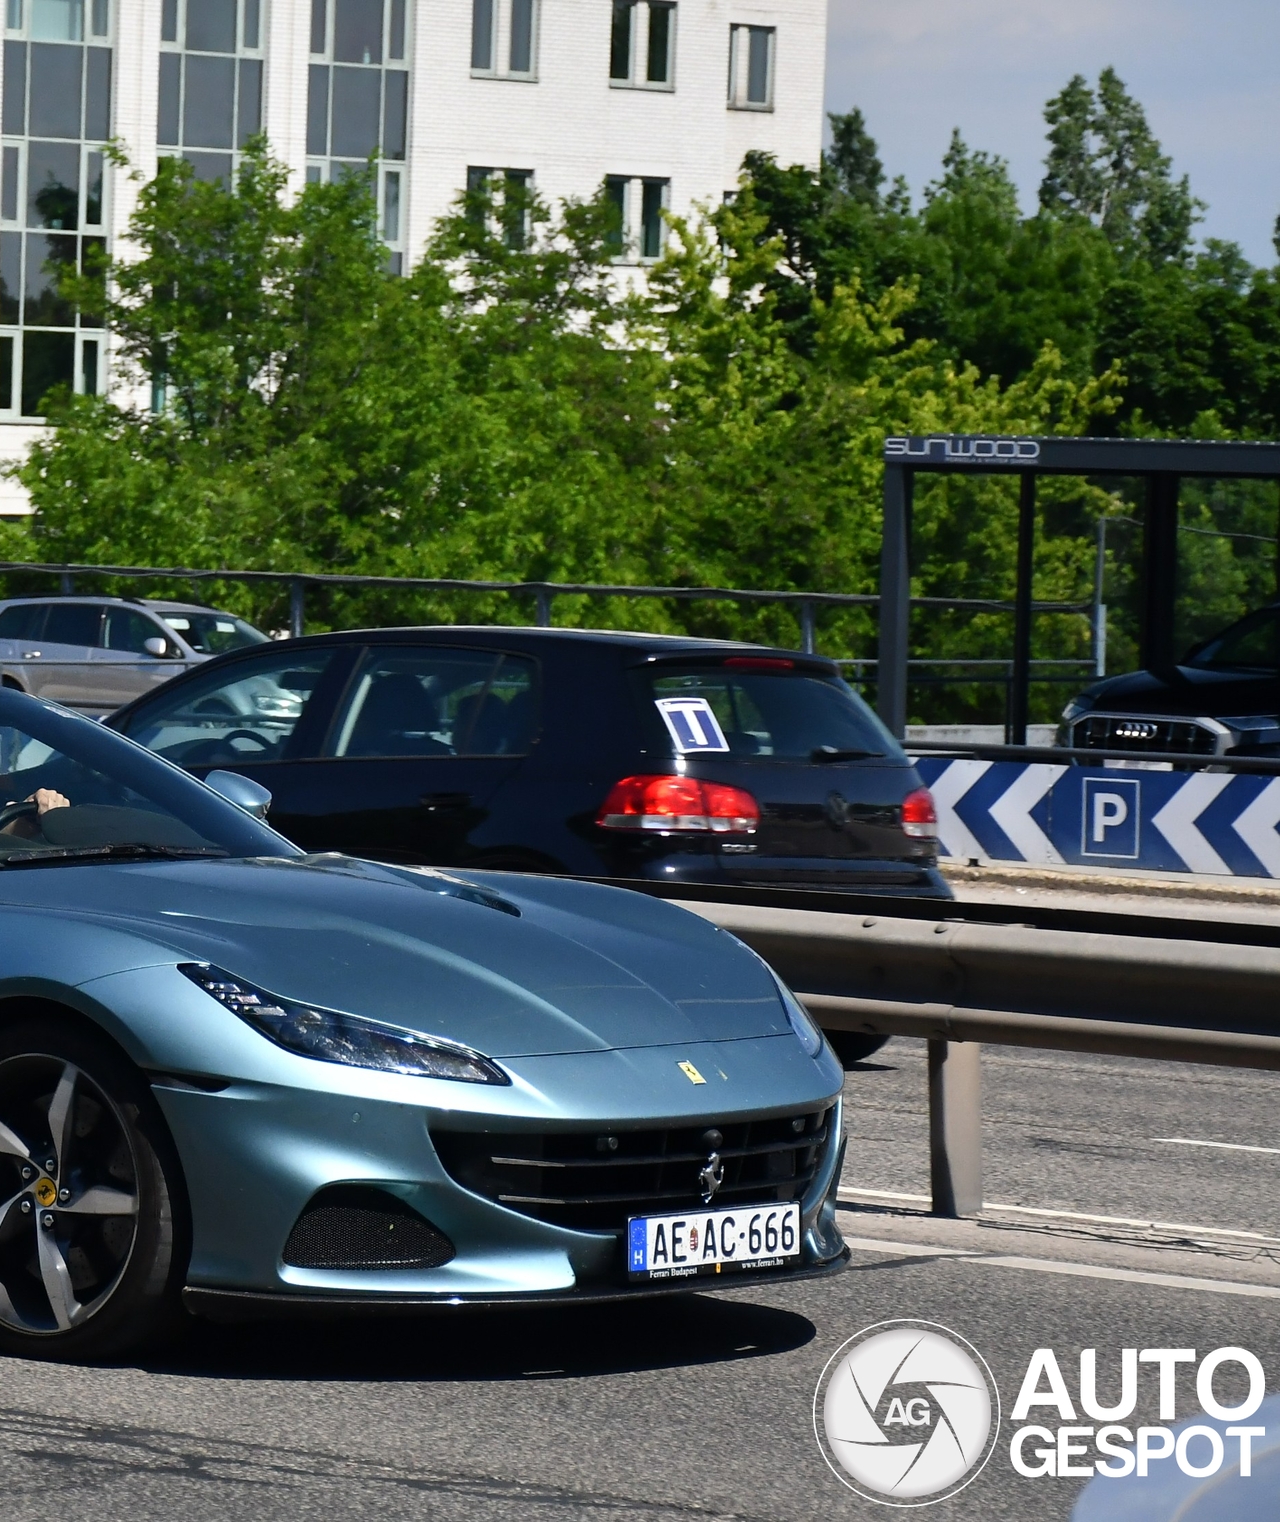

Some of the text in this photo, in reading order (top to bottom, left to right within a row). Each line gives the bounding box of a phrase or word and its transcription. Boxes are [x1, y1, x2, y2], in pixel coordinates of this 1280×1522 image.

[1093, 792, 1128, 842] P
[633, 1249, 643, 1265] H
[652, 1221, 687, 1265] AE
[649, 1266, 698, 1279] Ferrari Budapest
